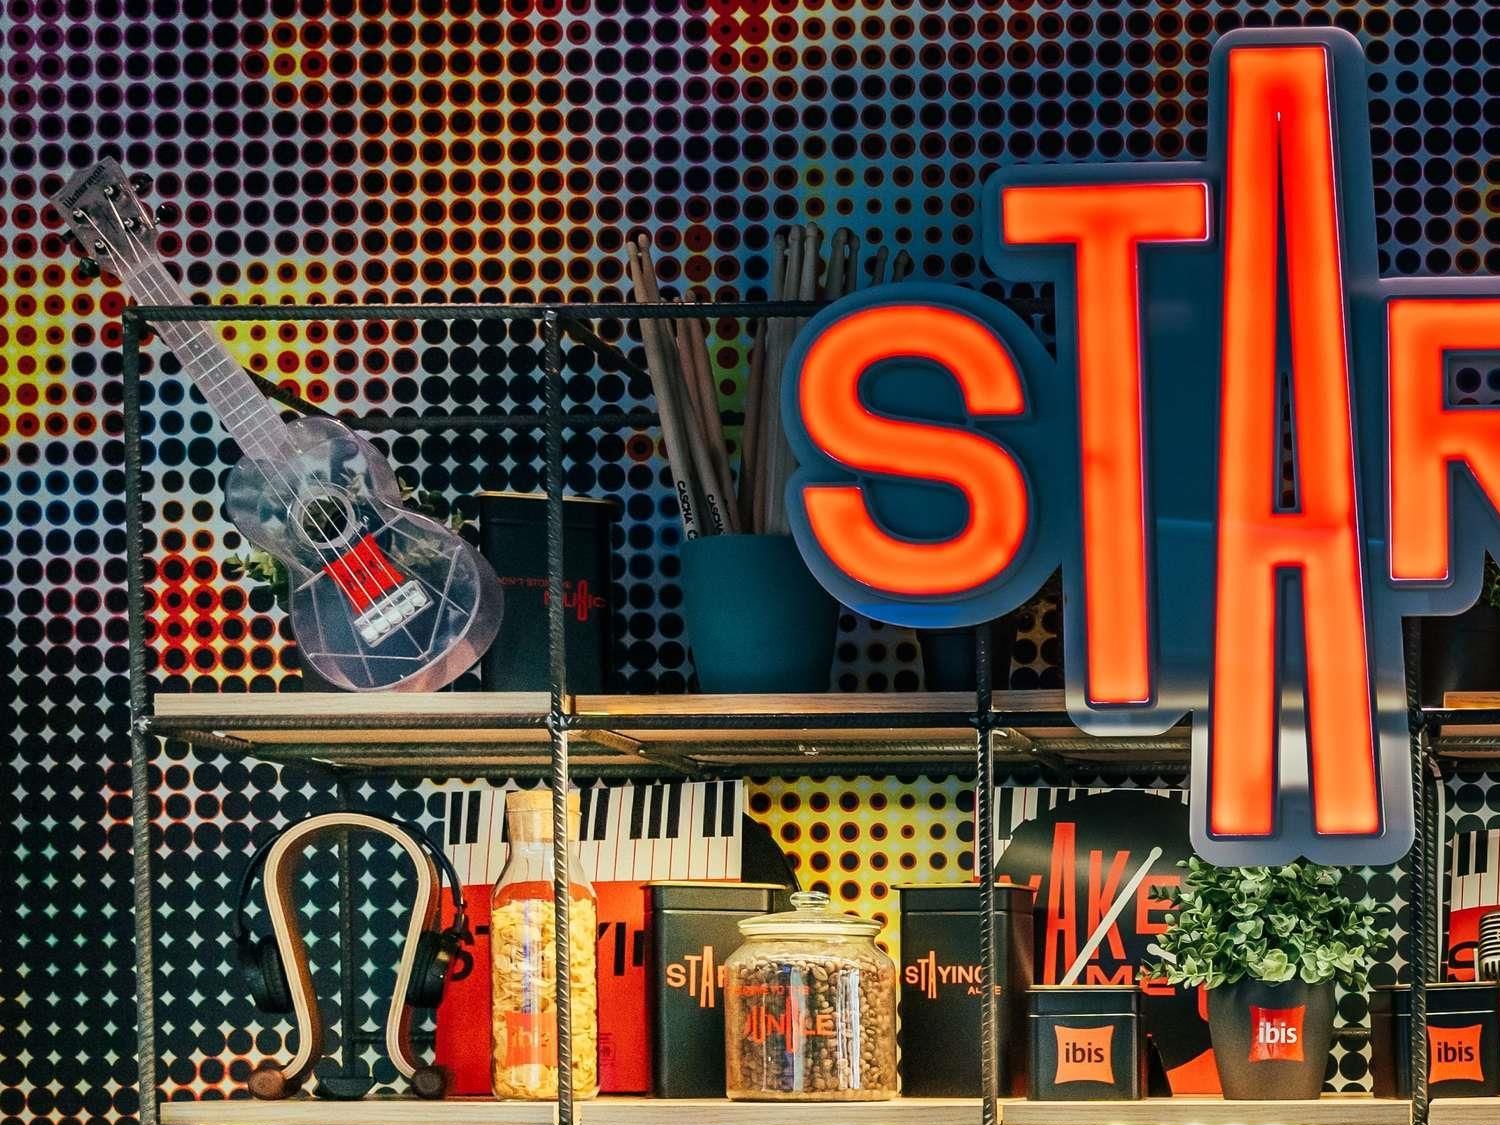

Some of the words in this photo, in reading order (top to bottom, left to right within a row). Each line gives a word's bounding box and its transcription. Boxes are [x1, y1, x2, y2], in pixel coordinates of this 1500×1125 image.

[677, 480, 694, 525] CASCHA
[667, 946, 725, 1007] STA
[967, 985, 1002, 995] ALE
[1258, 1019, 1298, 1045] ibis
[1064, 1038, 1106, 1064] ibis
[1437, 1039, 1475, 1064] ibis
